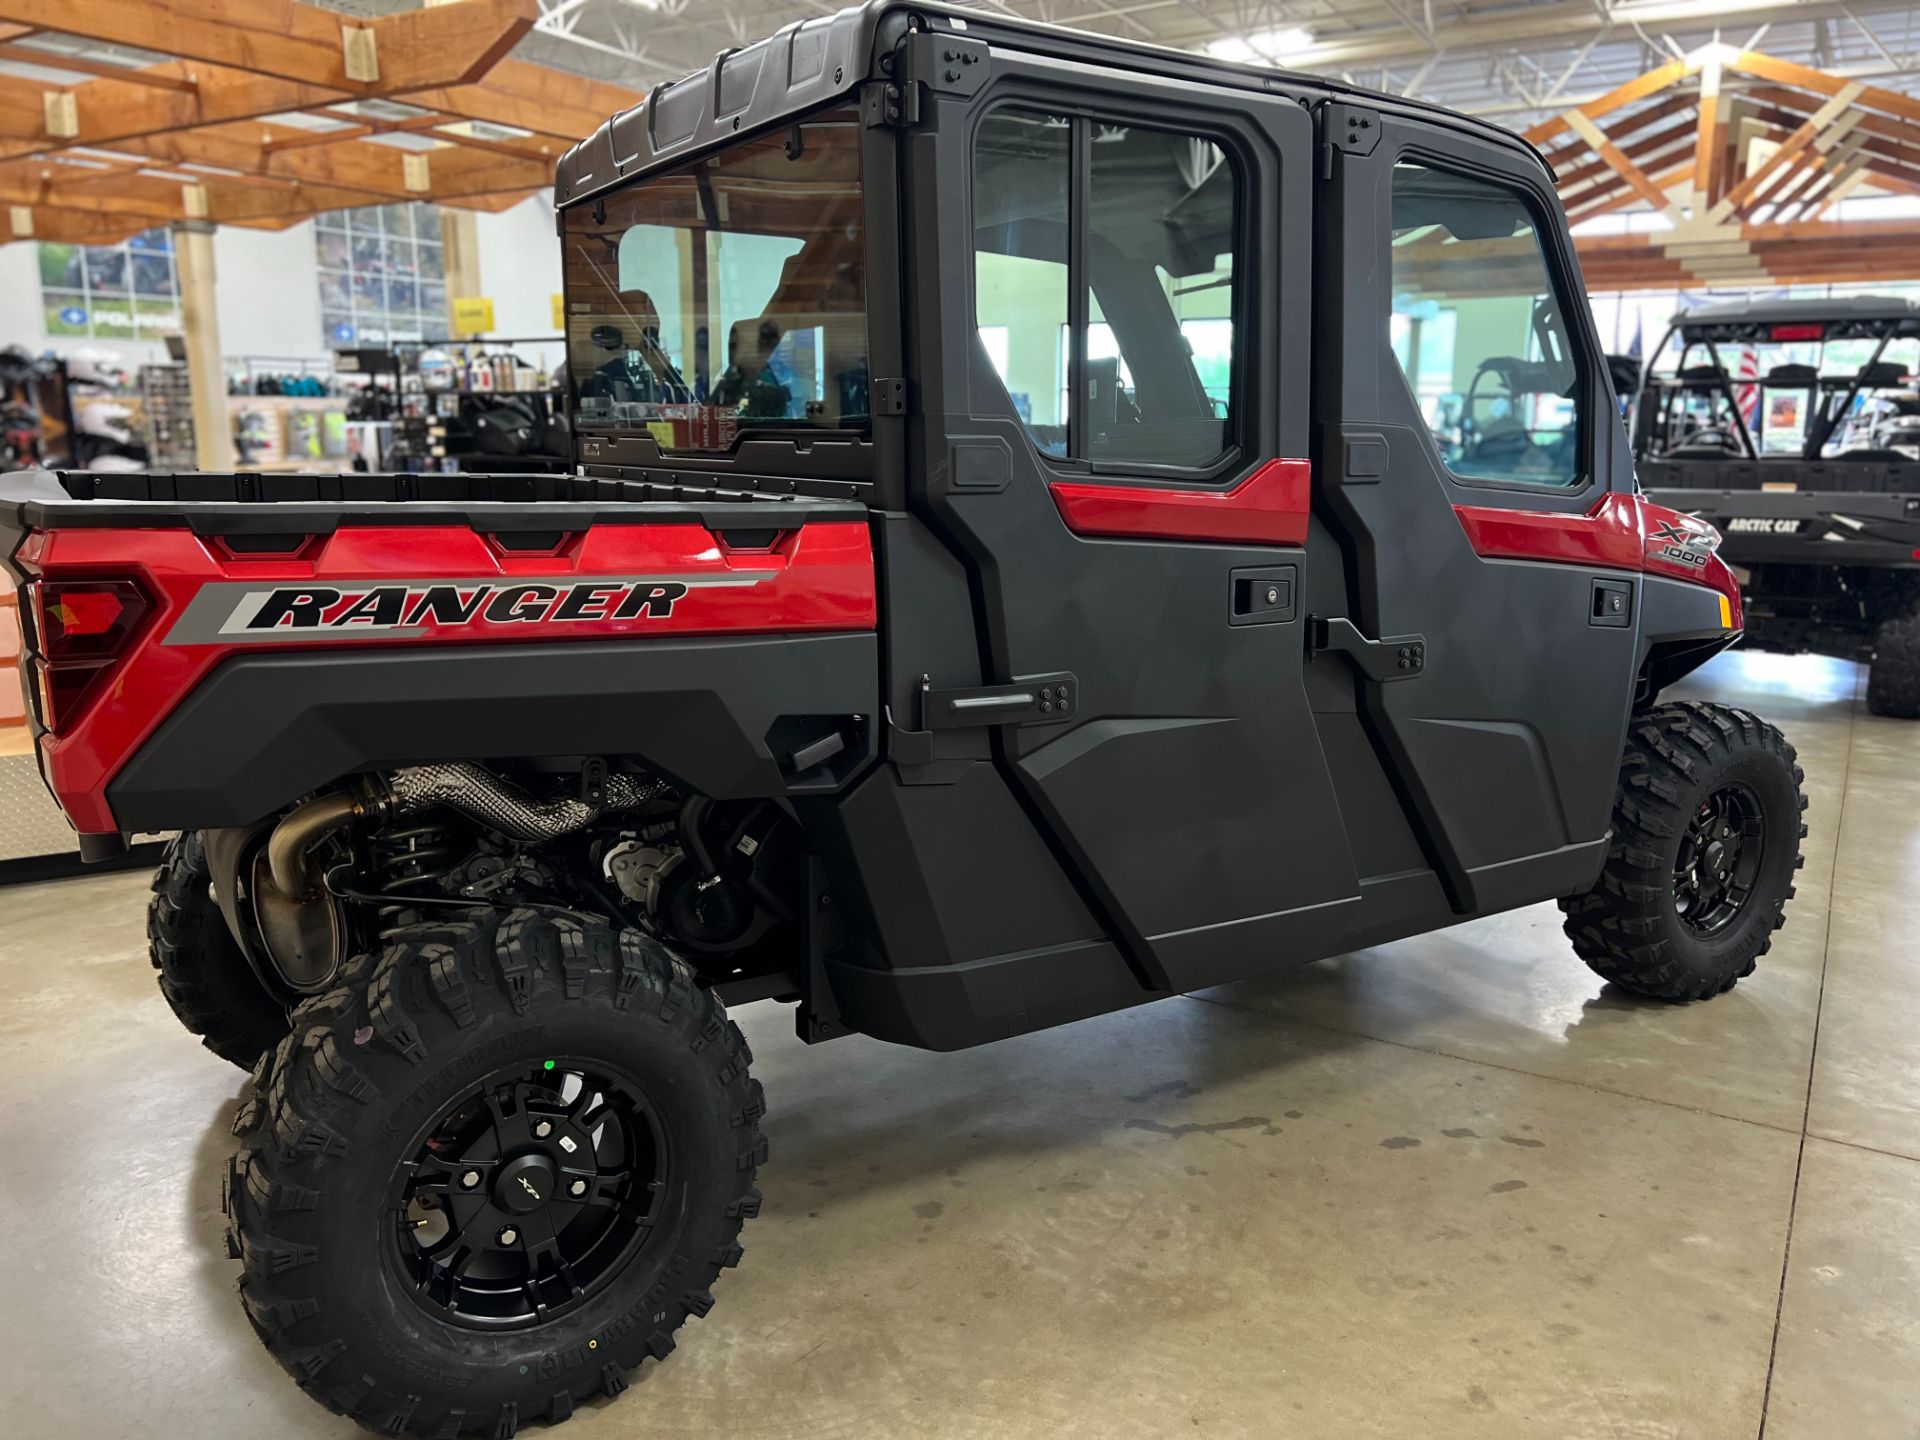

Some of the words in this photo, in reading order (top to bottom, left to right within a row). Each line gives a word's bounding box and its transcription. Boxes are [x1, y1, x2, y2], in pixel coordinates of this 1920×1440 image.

[1728, 518, 1770, 532] ARCTIC
[1773, 520, 1800, 533] CAT
[1662, 545, 1707, 567] 1000
[245, 581, 688, 629] RANGER
[515, 1176, 541, 1200] XP
